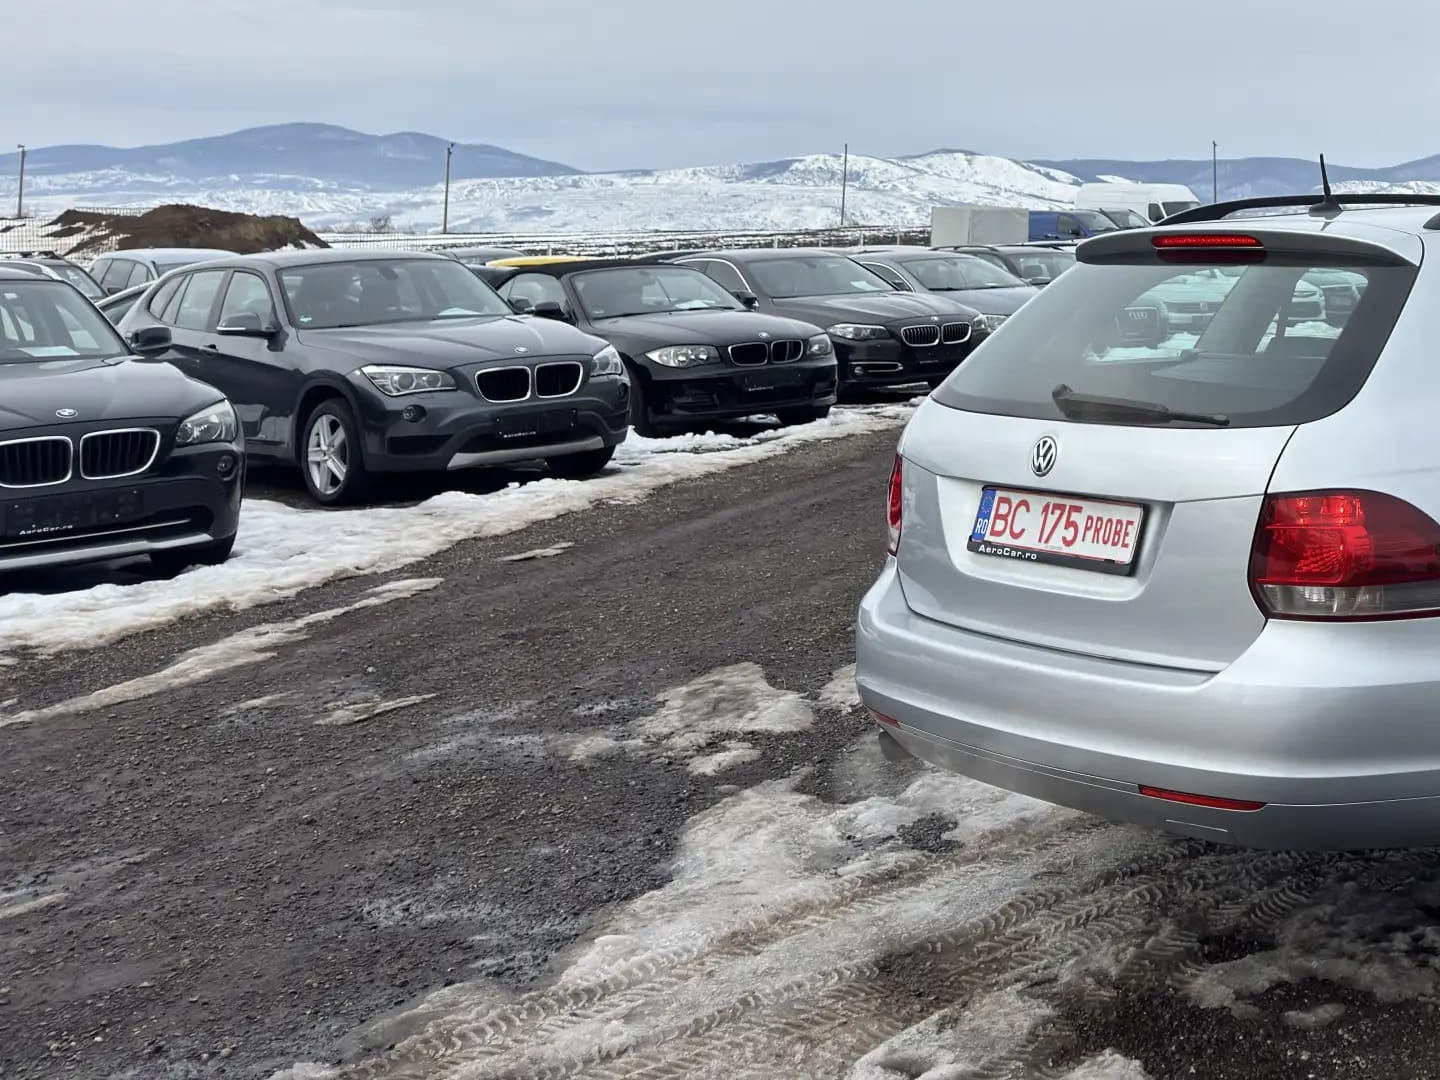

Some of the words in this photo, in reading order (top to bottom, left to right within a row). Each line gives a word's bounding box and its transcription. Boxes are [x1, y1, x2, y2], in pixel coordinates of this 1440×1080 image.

[975, 518, 989, 534] RO
[989, 497, 1030, 540] BC
[1038, 501, 1083, 547] 175
[1081, 514, 1135, 548] PROBE
[978, 544, 1037, 560] AeroCar.ro
